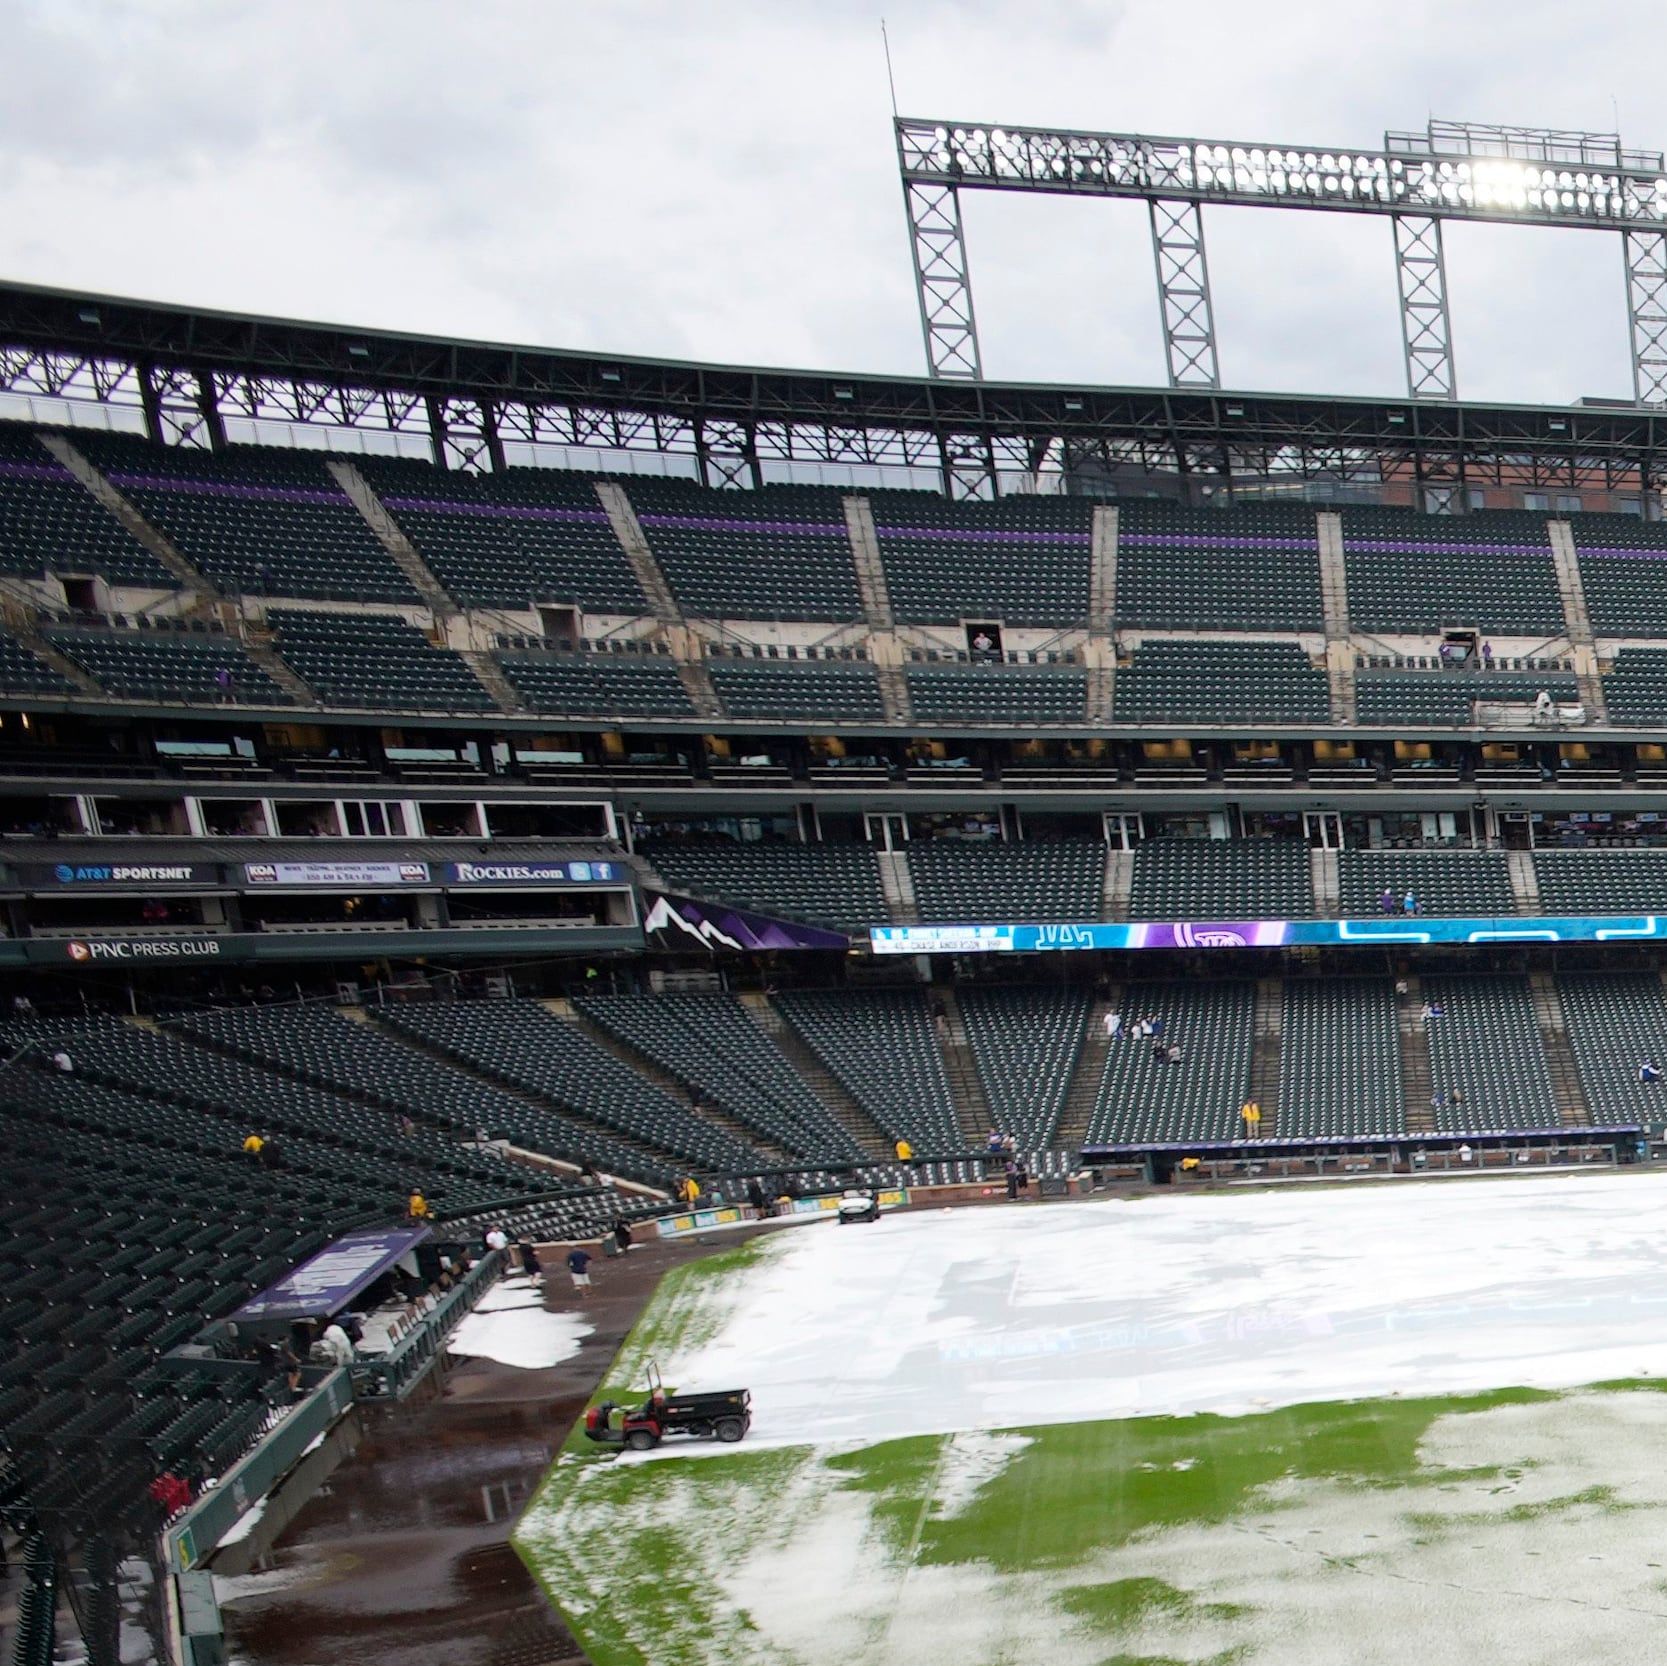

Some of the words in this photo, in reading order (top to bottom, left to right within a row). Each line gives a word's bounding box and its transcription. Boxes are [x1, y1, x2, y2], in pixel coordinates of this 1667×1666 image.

[77, 867, 111, 879] AT&T
[112, 867, 192, 880] SPORTSNET
[249, 864, 276, 875] KOA
[400, 864, 425, 875] KOA
[456, 862, 564, 882] ROCKIES.com
[88, 942, 133, 959] PNC
[133, 942, 180, 956] PRESS
[181, 941, 220, 954] CLUB
